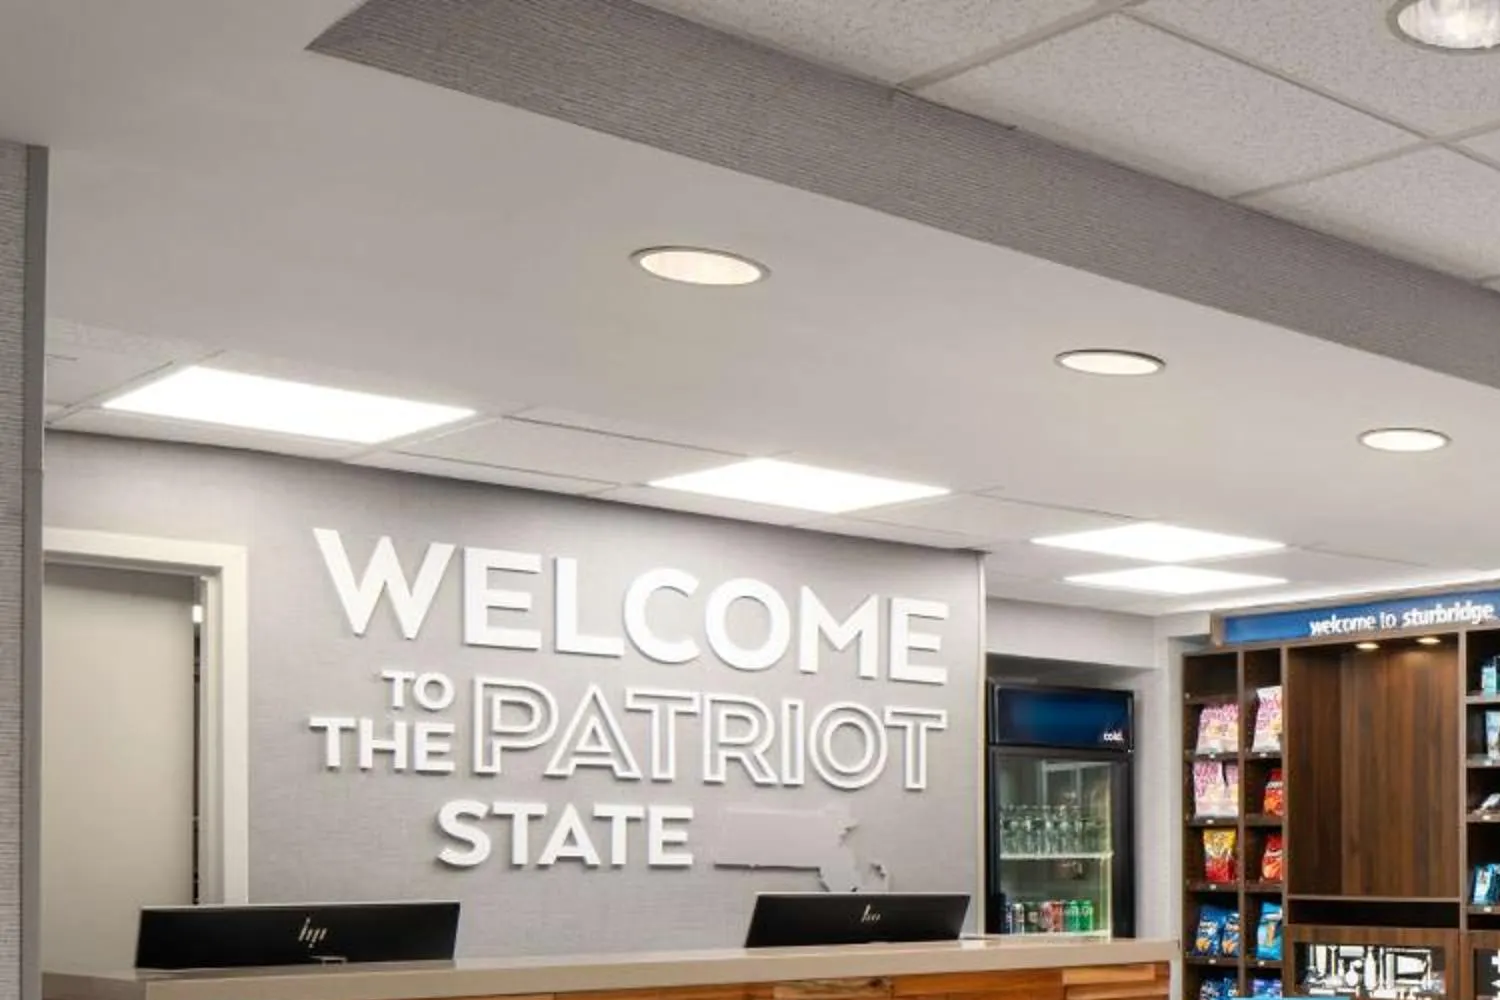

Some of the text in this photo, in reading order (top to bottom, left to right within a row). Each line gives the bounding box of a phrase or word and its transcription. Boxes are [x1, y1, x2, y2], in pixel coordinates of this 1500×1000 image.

[312, 527, 949, 685] WELCOME
[1309, 615, 1376, 637] welcome
[1380, 611, 1396, 629] to
[381, 669, 455, 711] TO
[309, 675, 948, 790] THE PATRIOT
[436, 800, 693, 868] STATE
